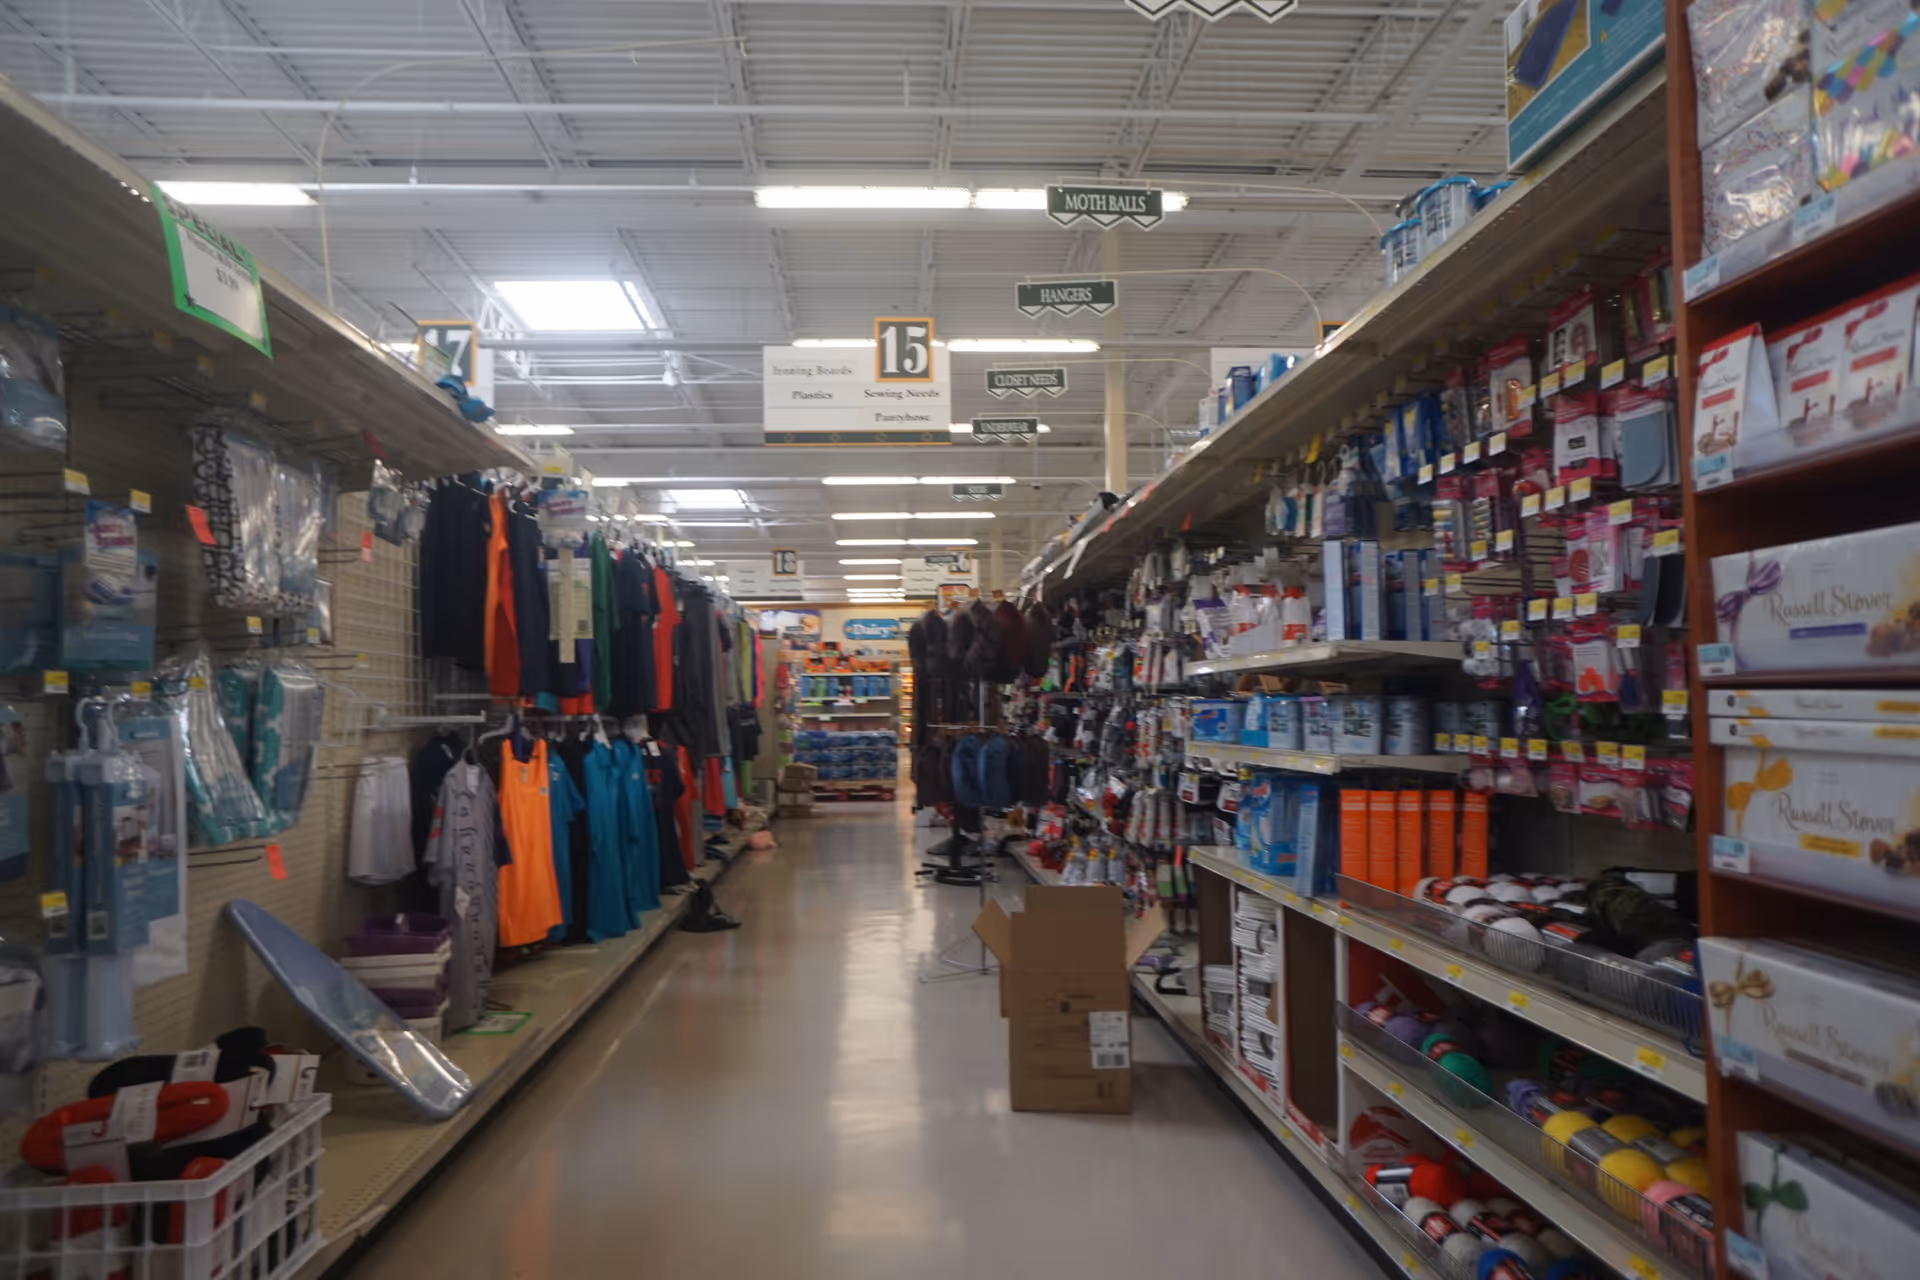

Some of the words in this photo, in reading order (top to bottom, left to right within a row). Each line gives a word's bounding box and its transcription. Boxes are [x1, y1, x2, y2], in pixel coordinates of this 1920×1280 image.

[1065, 193, 1107, 211] MOTH
[1108, 195, 1147, 212] BALLS
[1040, 287, 1093, 303] HANGERS
[880, 325, 929, 374] 15
[771, 365, 813, 377] Ironing
[815, 365, 853, 376] Boards
[994, 373, 1028, 387] CLOSET
[1029, 373, 1058, 386] NEEDS
[791, 389, 834, 400] Plastics
[863, 388, 903, 400] Sewing
[905, 388, 941, 399] Needs
[874, 412, 932, 424] Pantyhose
[776, 551, 797, 573] 18
[1763, 590, 1827, 627] Russell
[1830, 584, 1892, 617] Stover
[852, 623, 892, 638] Dairy
[1772, 791, 1833, 831] Russell
[1837, 801, 1896, 833] Stover
